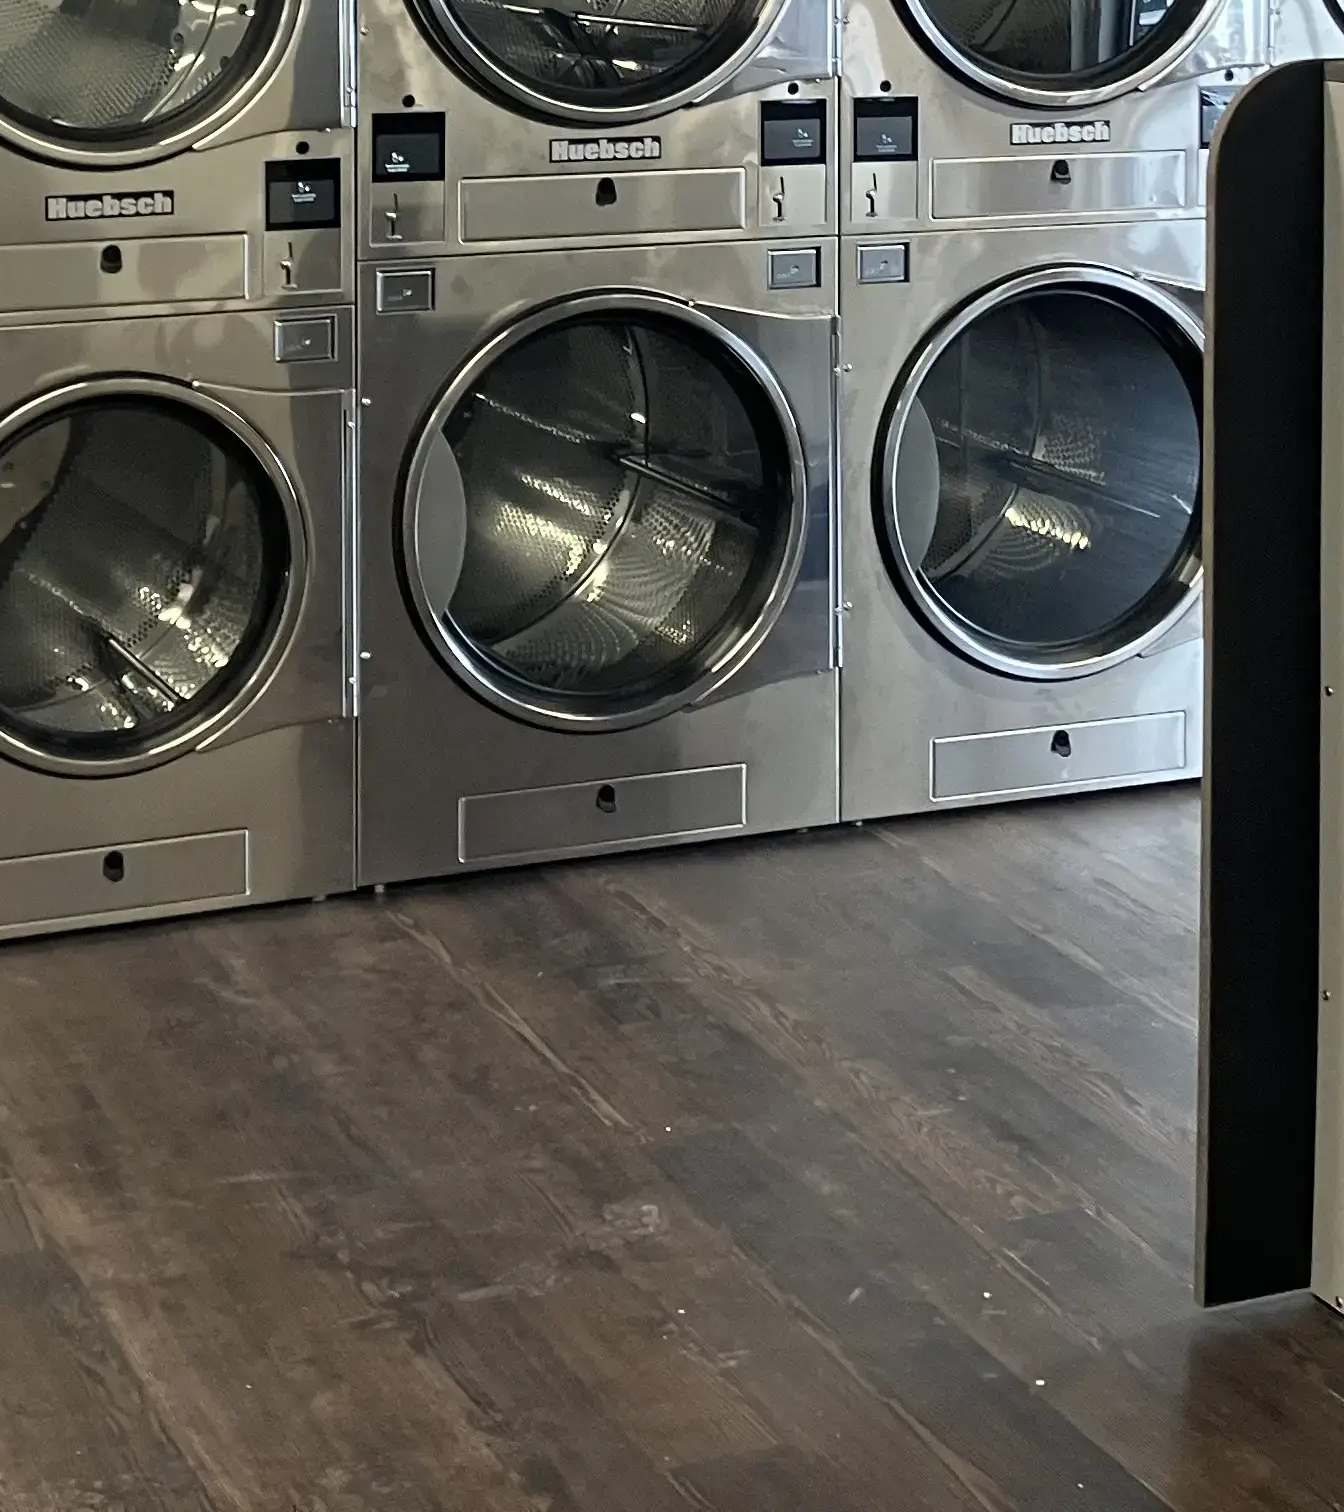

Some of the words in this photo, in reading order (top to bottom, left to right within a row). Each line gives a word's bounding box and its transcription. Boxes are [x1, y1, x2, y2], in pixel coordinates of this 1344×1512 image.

[1012, 121, 1109, 144] Huebsch
[551, 137, 660, 161] Huebsch
[47, 192, 172, 219] Huebsch
